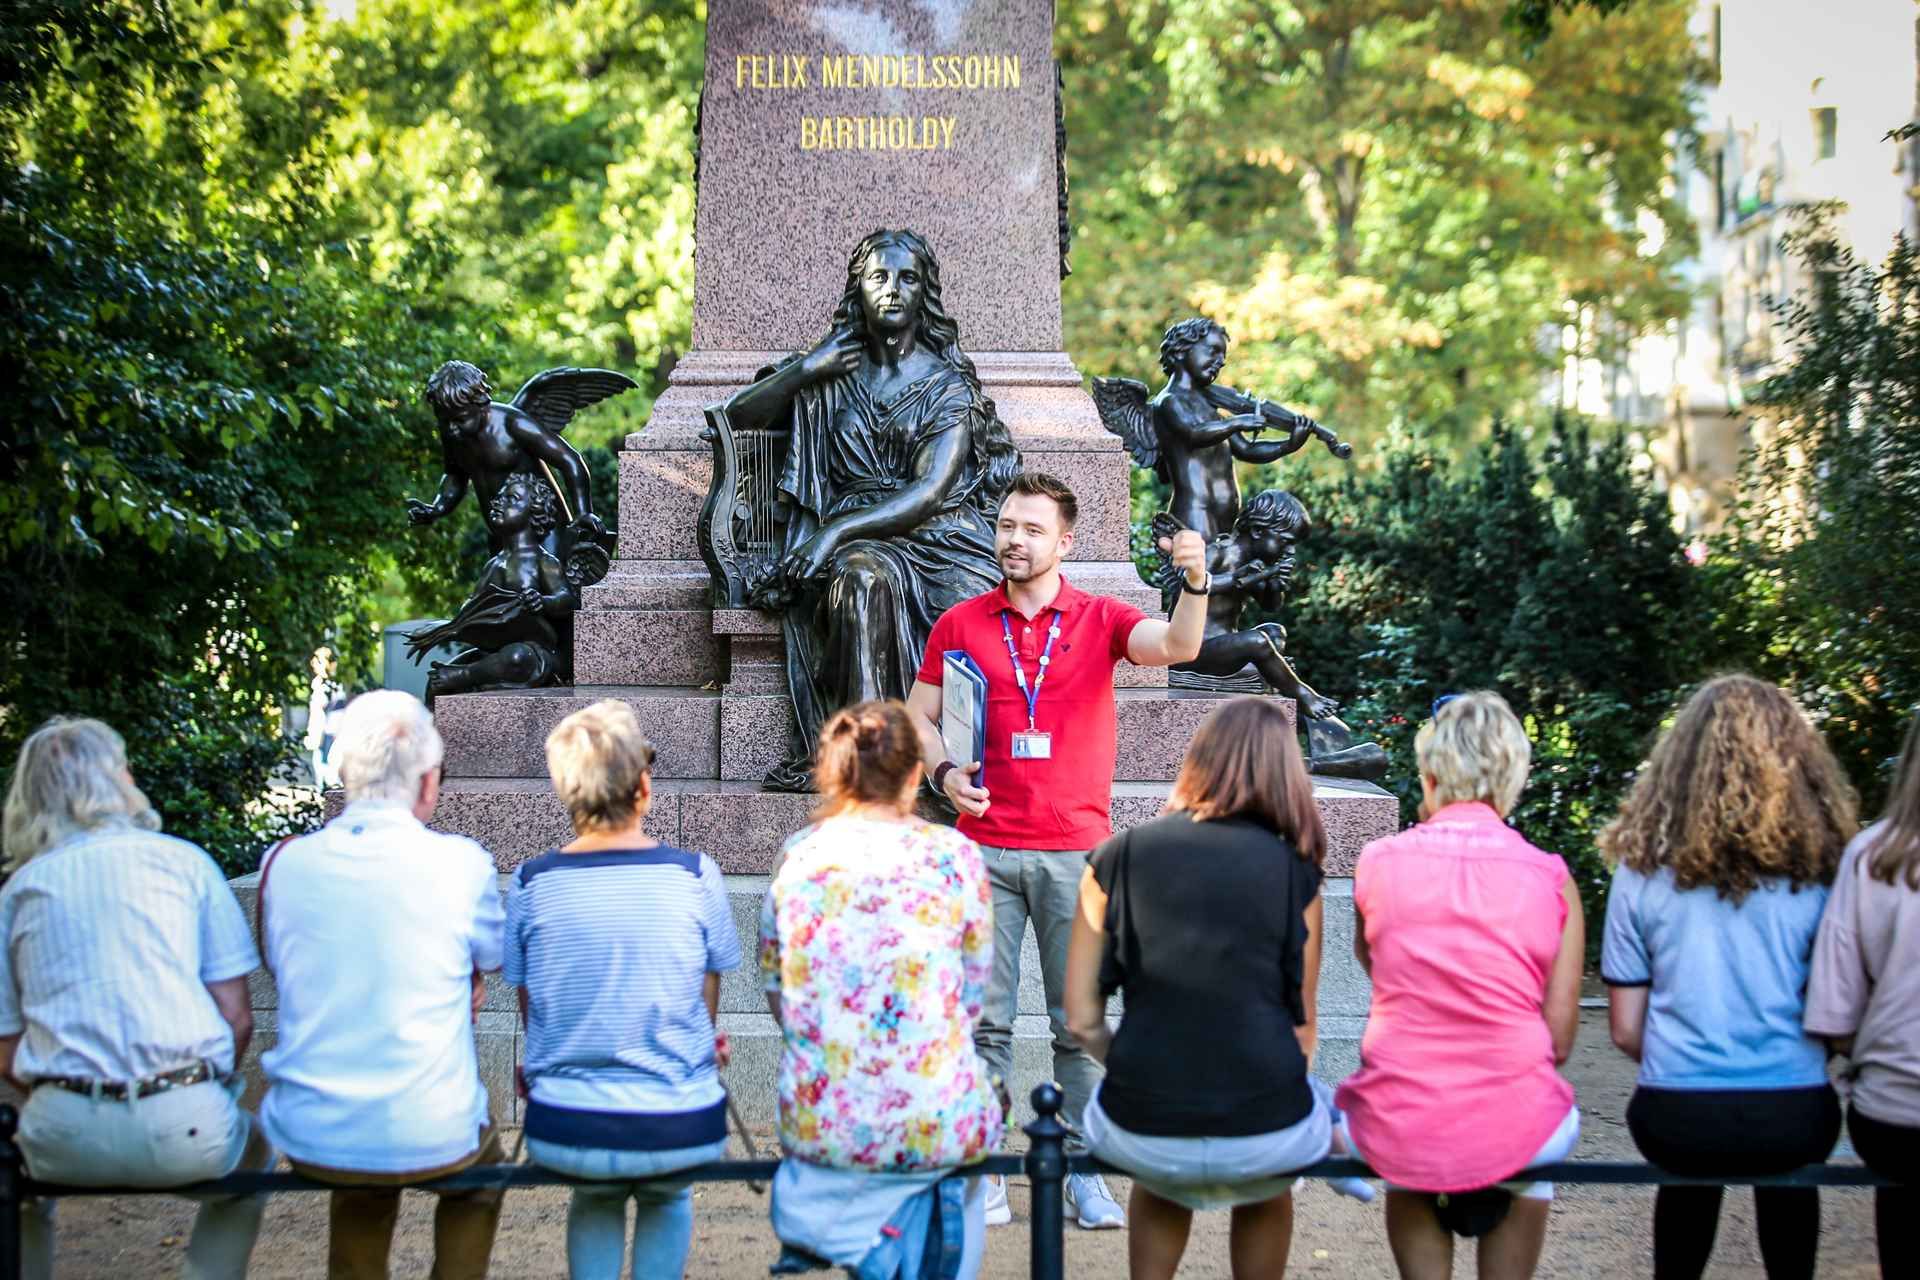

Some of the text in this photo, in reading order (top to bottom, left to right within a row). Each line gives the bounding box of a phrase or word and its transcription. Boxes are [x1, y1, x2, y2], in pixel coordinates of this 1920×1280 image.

[736, 54, 1020, 89] FELIX MENDELSSOHN
[801, 115, 956, 150] BARTHOLDY
